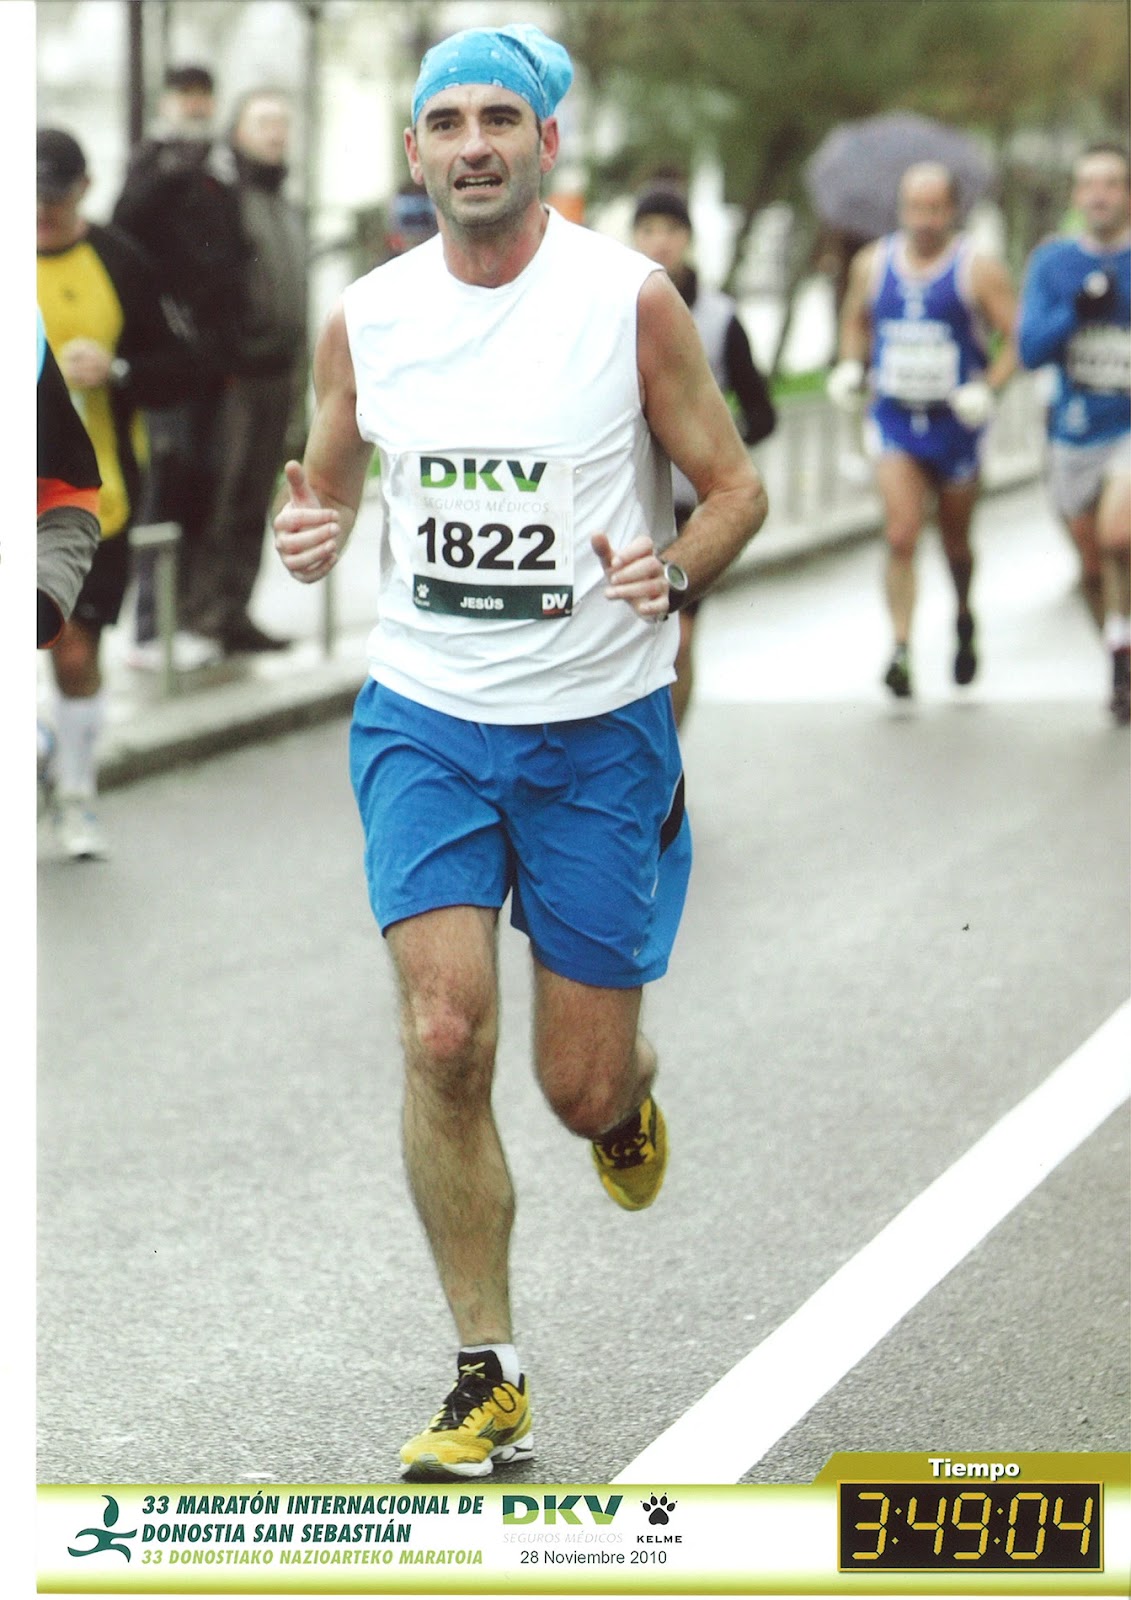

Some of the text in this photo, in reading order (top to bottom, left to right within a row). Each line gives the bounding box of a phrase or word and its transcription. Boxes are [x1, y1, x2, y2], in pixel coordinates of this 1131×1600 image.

[419, 456, 548, 493] DKV
[485, 499, 550, 513] MÉDICOS
[417, 516, 556, 571] 1822
[460, 596, 504, 610] JESÚS
[542, 593, 569, 609] DV
